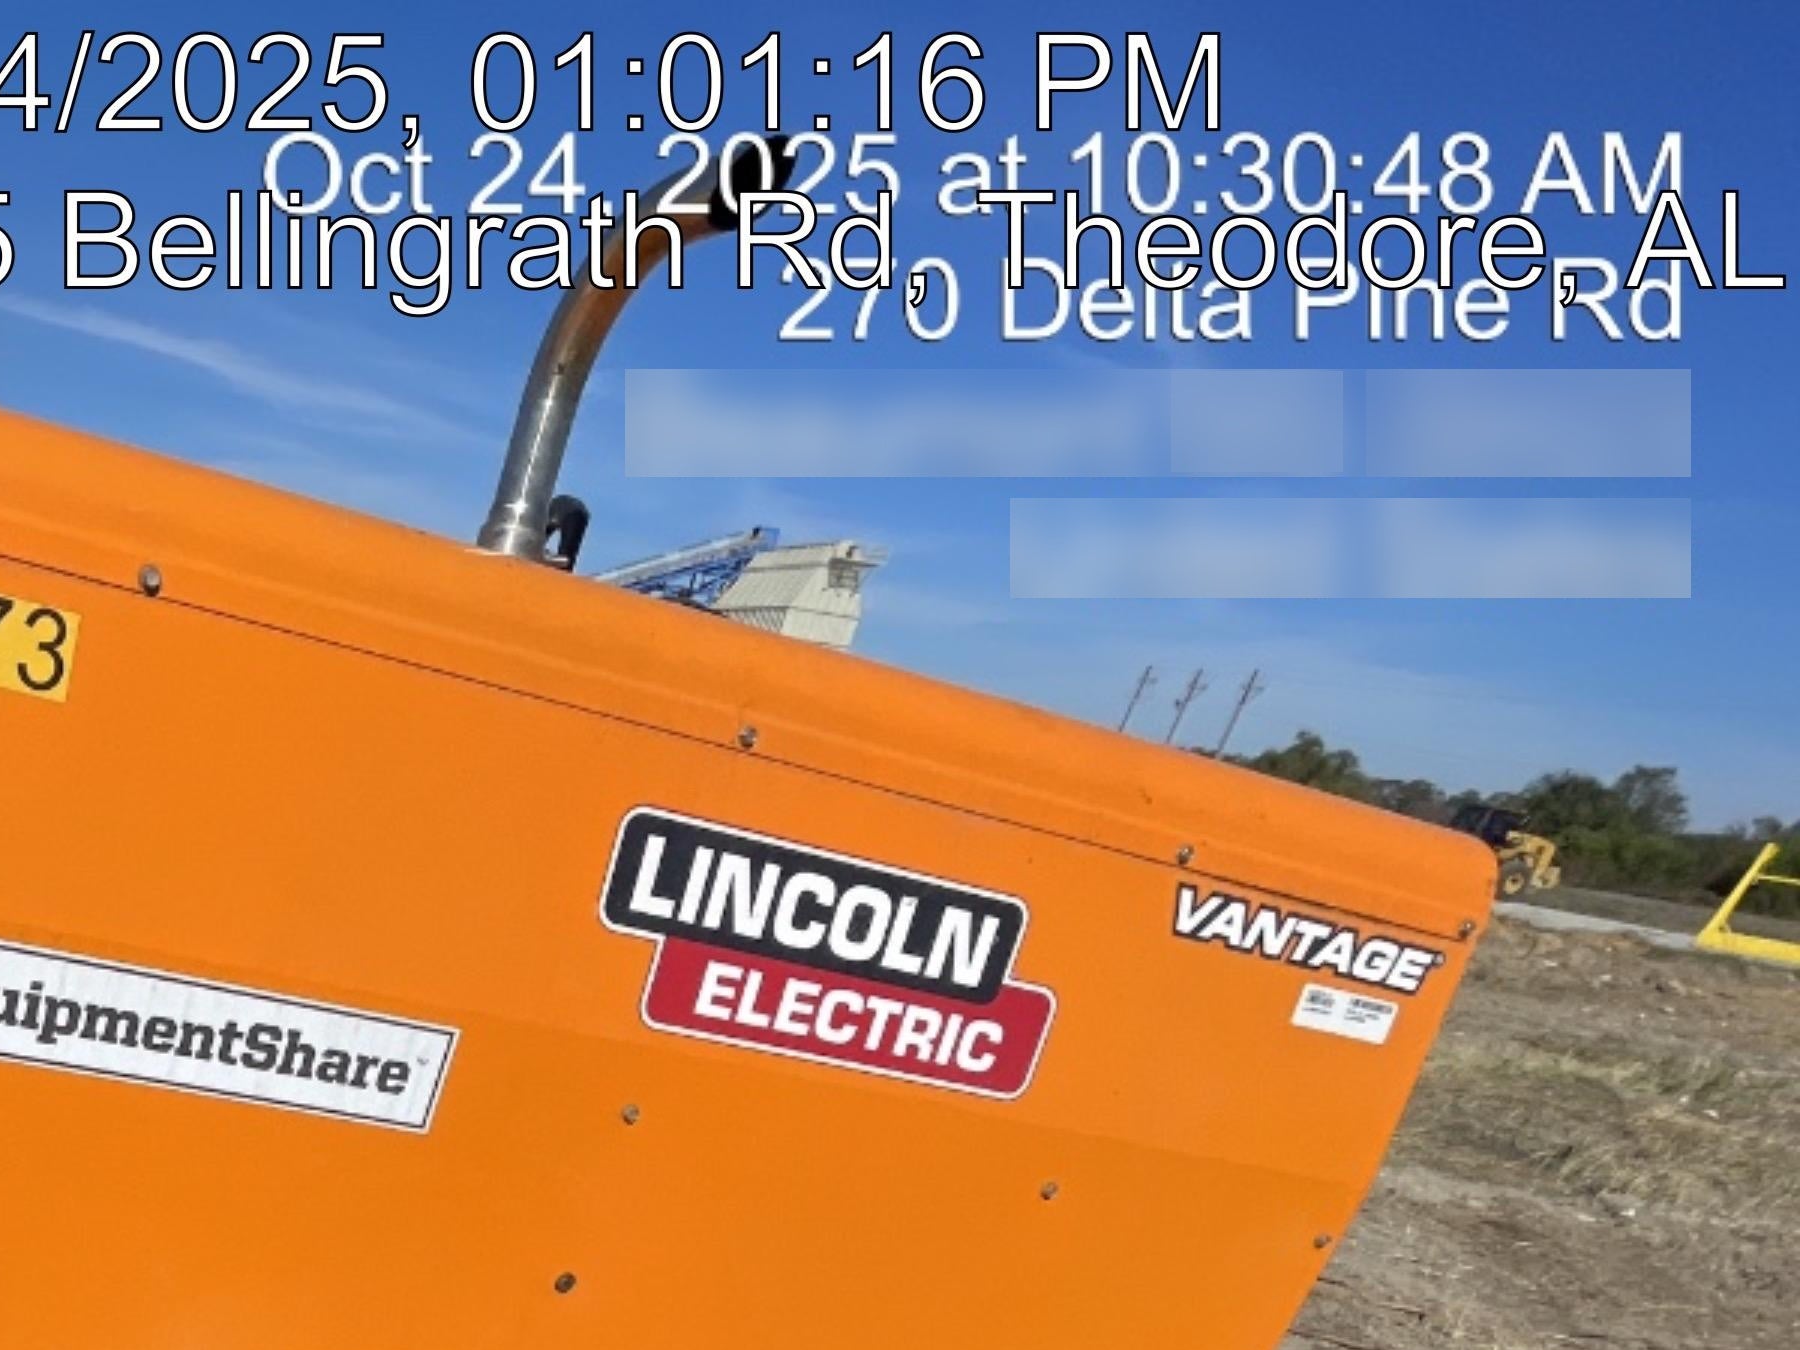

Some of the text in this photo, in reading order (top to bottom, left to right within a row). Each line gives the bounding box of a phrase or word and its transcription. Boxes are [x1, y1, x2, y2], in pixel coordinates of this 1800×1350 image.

[628, 834, 1002, 989] LINCOLN
[1173, 881, 1437, 996] VANTAGE
[694, 960, 1004, 1074] ELECTRIC
